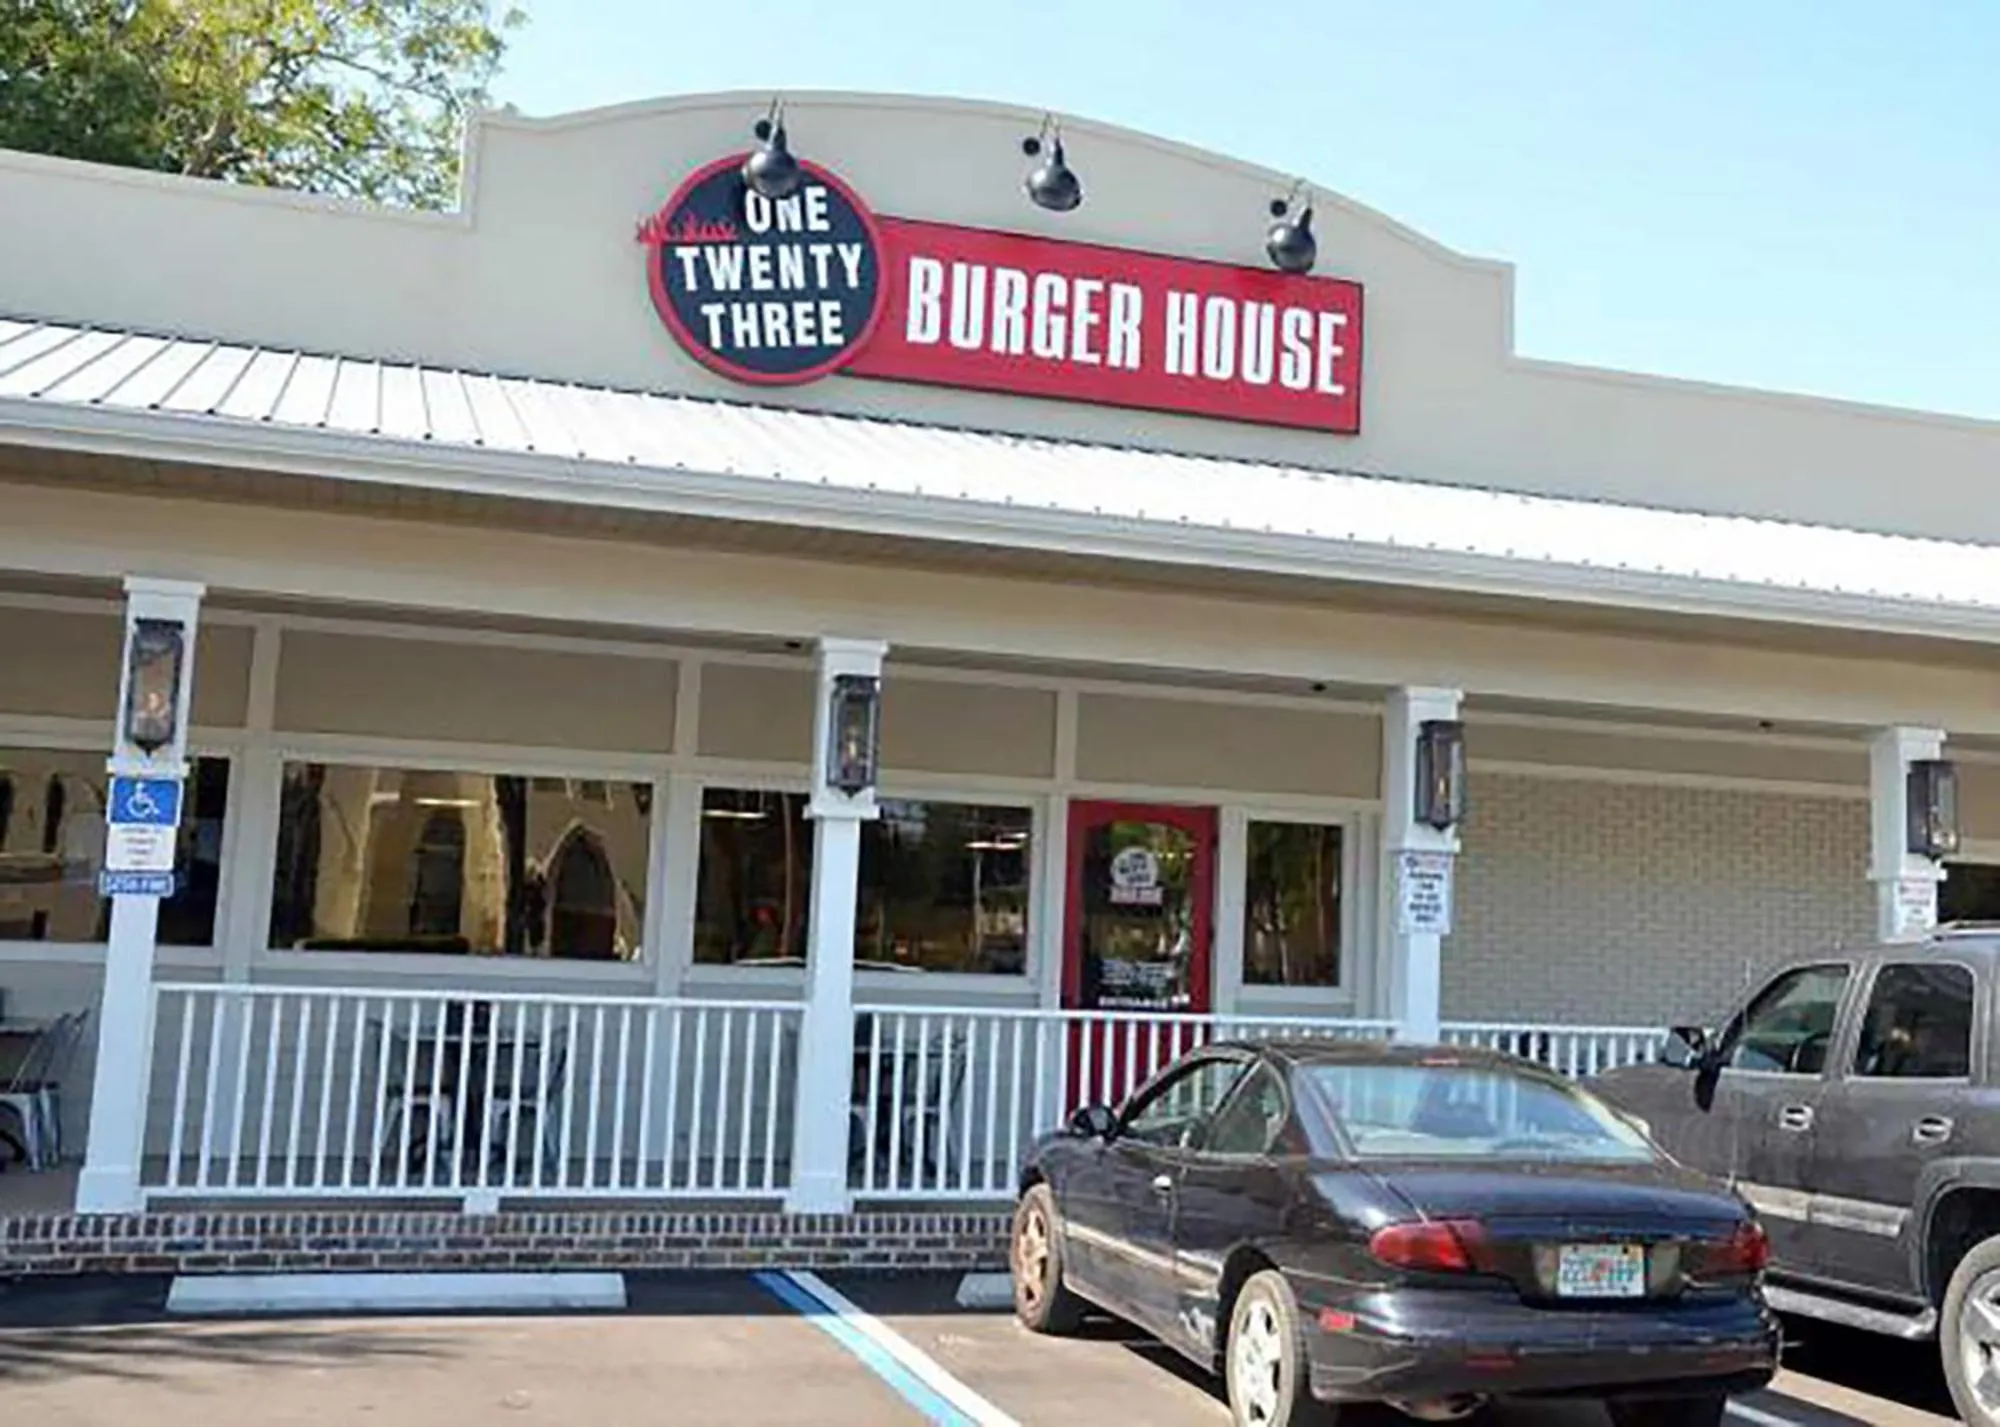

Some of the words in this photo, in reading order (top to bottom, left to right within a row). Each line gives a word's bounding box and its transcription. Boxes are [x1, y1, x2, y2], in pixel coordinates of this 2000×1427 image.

[745, 186, 830, 233] ONE
[675, 243, 862, 291] TWENTY
[701, 300, 846, 349] THREE
[906, 256, 1143, 370] BURGER
[1165, 291, 1348, 396] HOUSE
